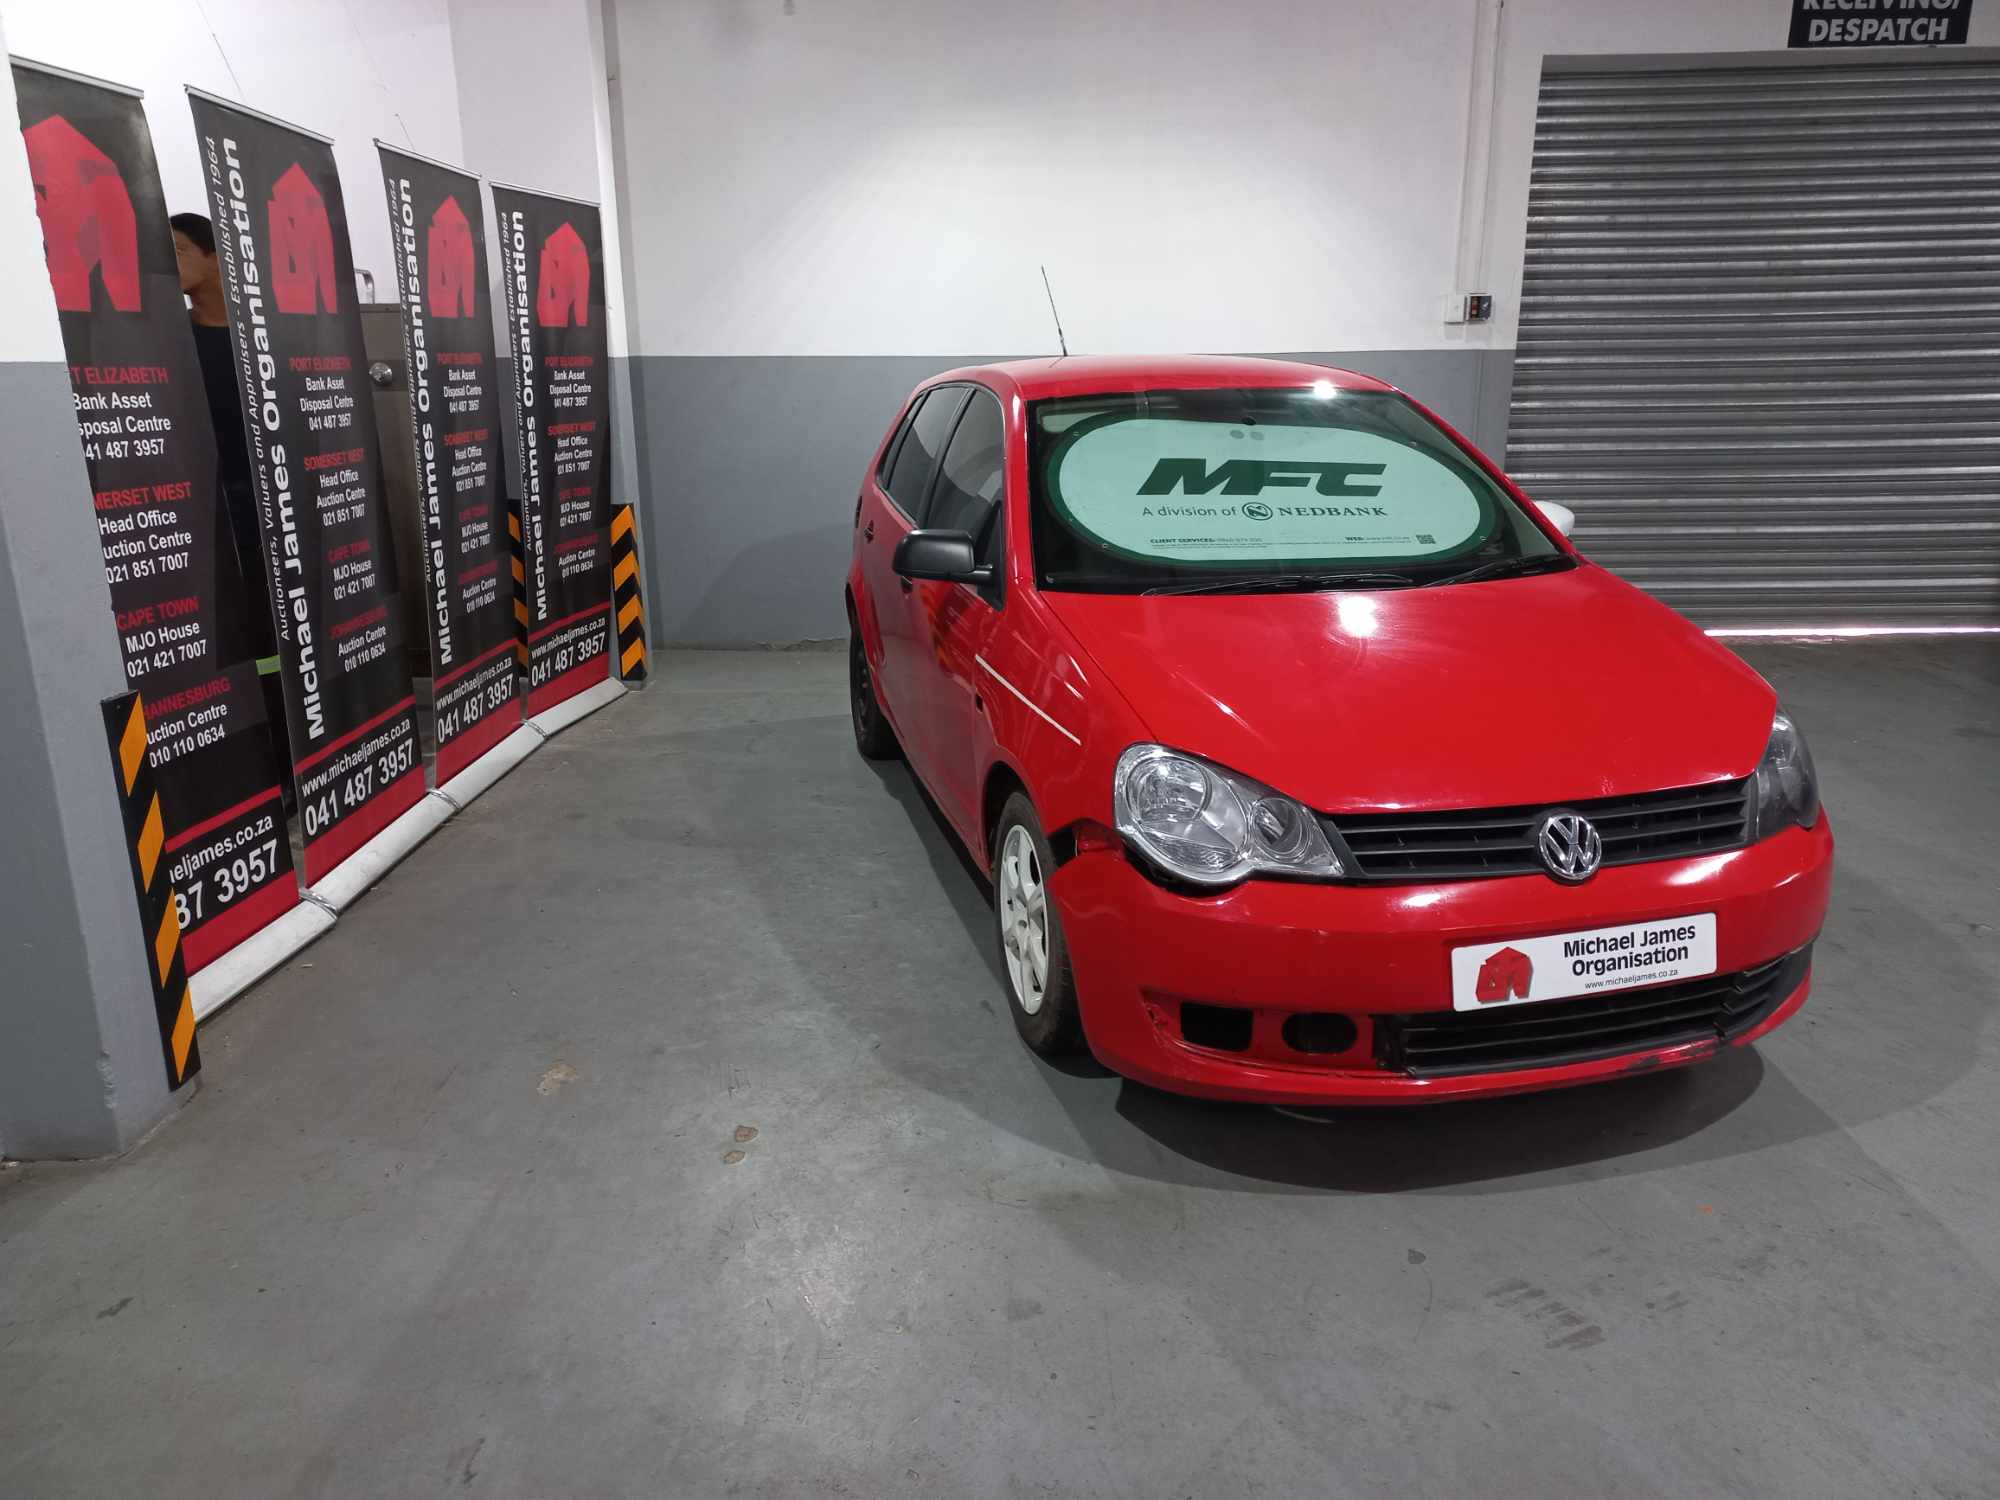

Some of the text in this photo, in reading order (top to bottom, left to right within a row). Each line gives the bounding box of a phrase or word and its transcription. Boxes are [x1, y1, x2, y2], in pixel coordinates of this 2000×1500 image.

[1808, 18, 1949, 41] DESPATCH
[205, 135, 223, 186] 1964
[213, 191, 241, 305] Established
[84, 367, 168, 384] ELIZABETH
[236, 321, 258, 420] Appraisers
[305, 376, 345, 391] Bank Asset
[111, 392, 152, 408] Asset
[300, 397, 333, 413] Disposal
[125, 415, 172, 433] Centre
[309, 416, 322, 431] 041
[323, 415, 336, 429] 487
[400, 179, 453, 665] Michael James Organisation
[512, 211, 547, 621] Michael James Organisation
[106, 440, 129, 458] 487
[133, 438, 164, 457] 3957
[223, 138, 325, 741] Michael James Organisation
[250, 423, 264, 459] and
[153, 481, 193, 501] WEST
[319, 473, 338, 488] Head
[1136, 457, 1387, 497] MFC
[257, 463, 273, 529] Valuers
[316, 491, 345, 509] Auction
[1142, 503, 1387, 518] A division of NEDBANK
[98, 509, 177, 535] Head Office
[322, 512, 336, 527] 021
[337, 509, 350, 523] 851
[149, 531, 192, 550] Centre
[105, 552, 189, 584] 021 851 7007
[350, 559, 372, 574] House
[269, 536, 290, 641] Auctioneers,
[334, 585, 346, 600] 021
[116, 597, 199, 631] CAPE TOWN
[126, 622, 200, 653] MJO House
[338, 638, 365, 657] Auction
[127, 639, 207, 678] 021 421 7007
[531, 631, 606, 687] 041 487 3957
[187, 703, 228, 728] Centre
[437, 673, 514, 743] 041 487 3957
[149, 723, 226, 768] 010 110 0634
[301, 718, 411, 797] www.michaeljames.co.za
[305, 738, 413, 836] 041 487 3957
[214, 838, 278, 903] 3957
[1564, 924, 1697, 958] Michael James
[1572, 945, 1690, 978] Organisation
[1584, 968, 1679, 990] www.michaeljames.co.za
